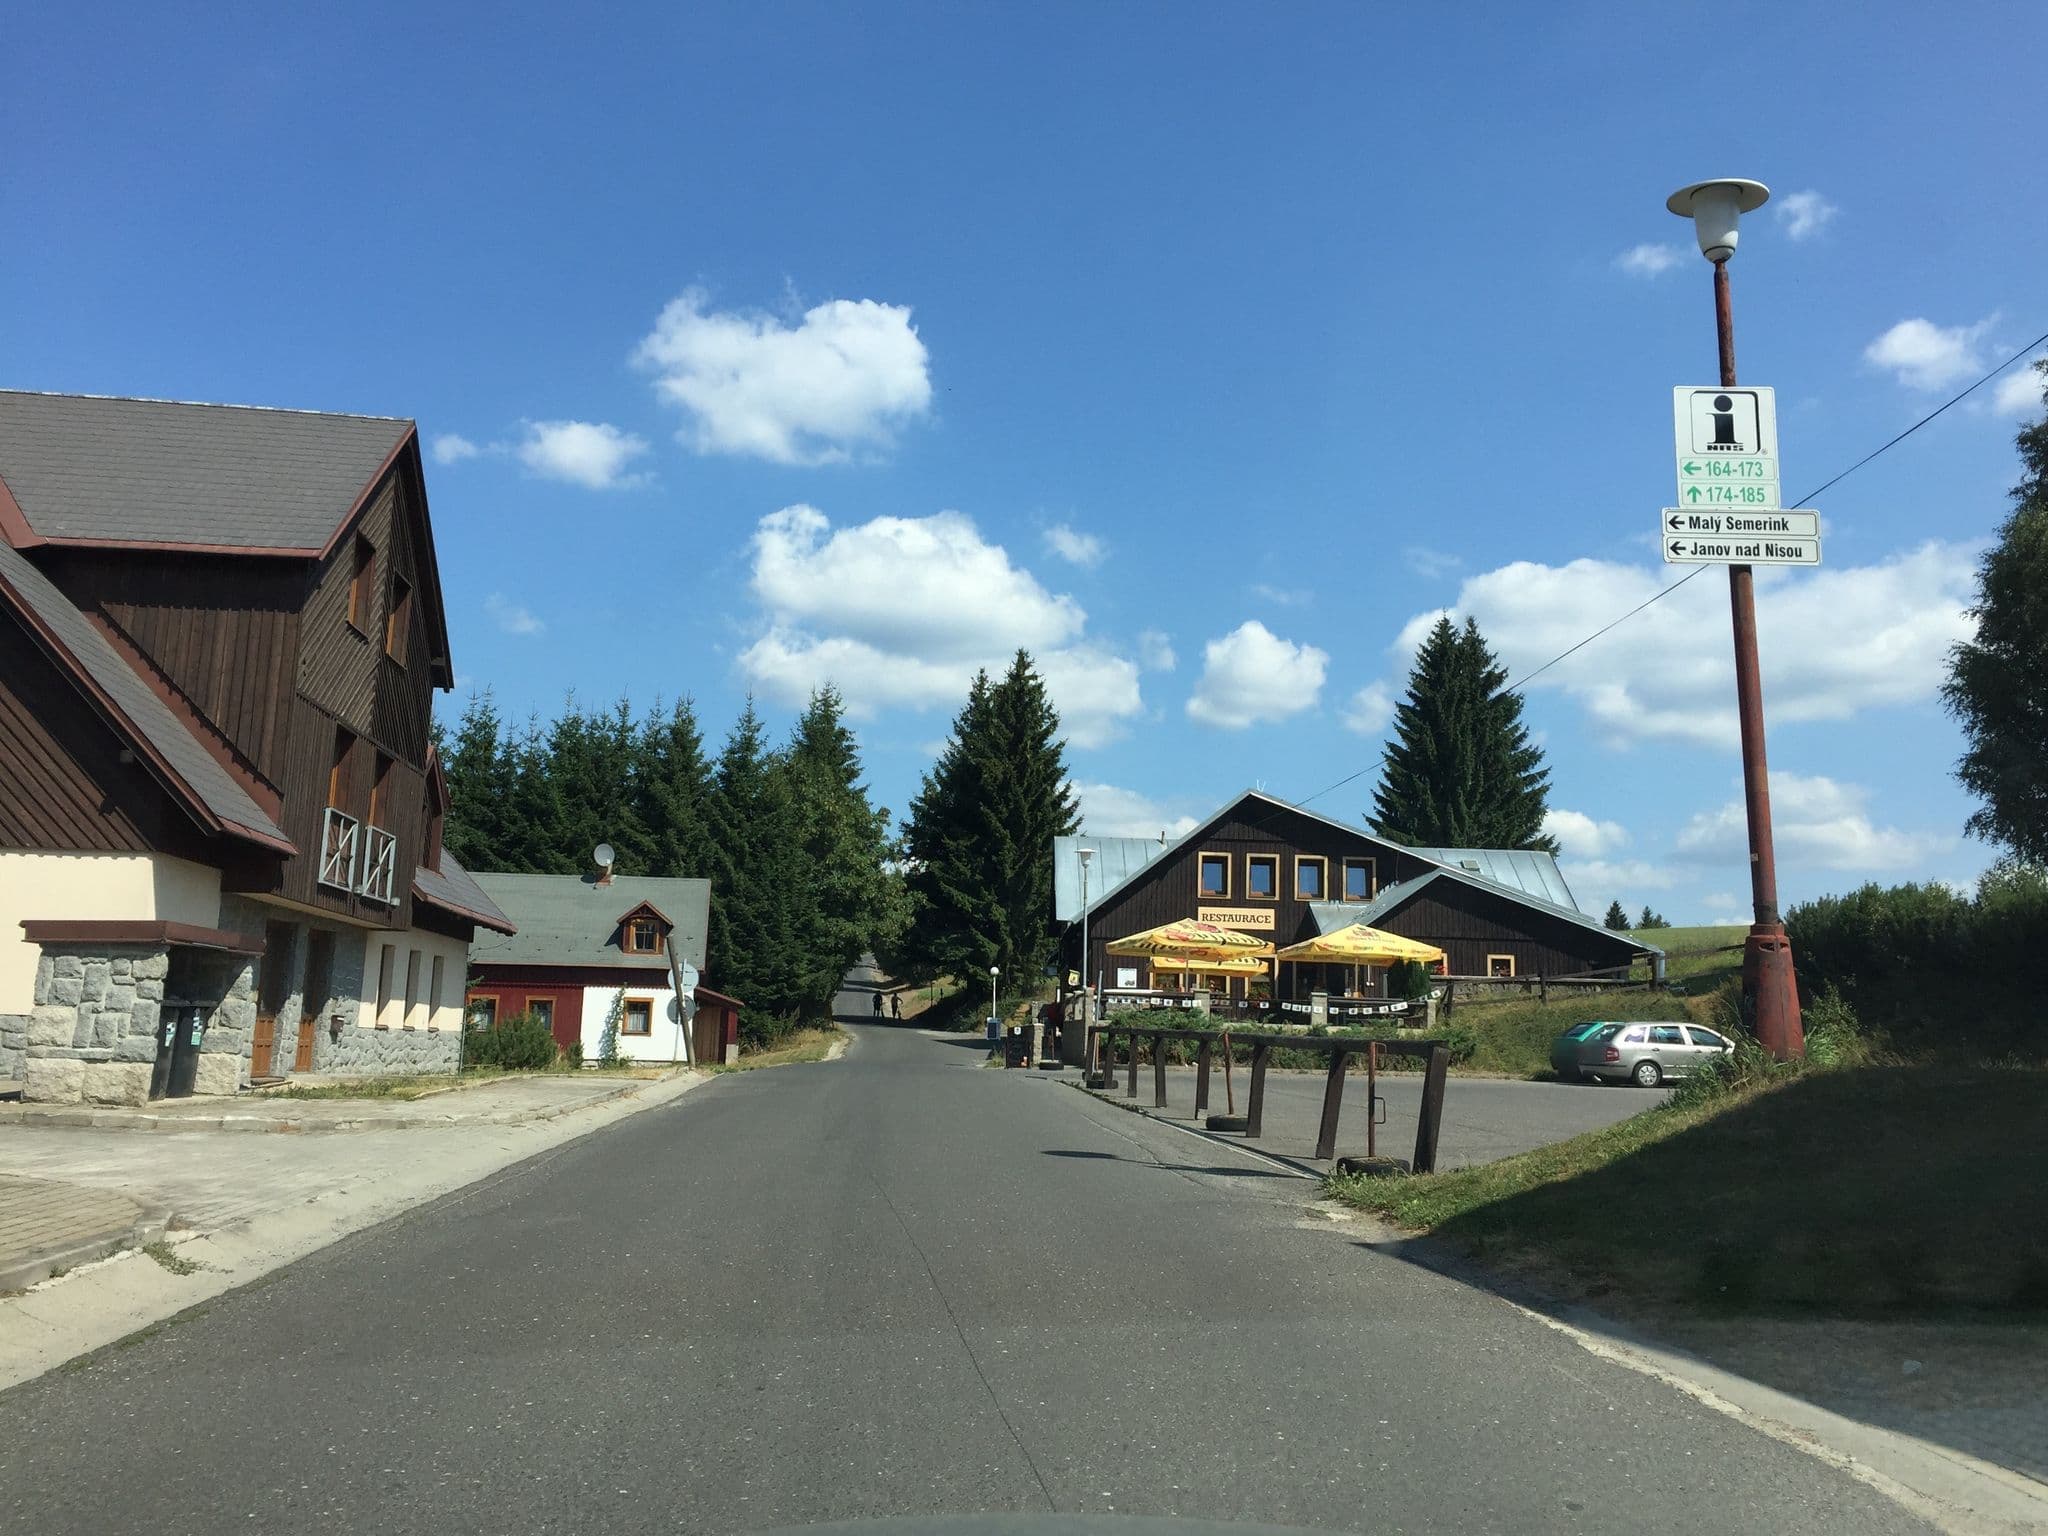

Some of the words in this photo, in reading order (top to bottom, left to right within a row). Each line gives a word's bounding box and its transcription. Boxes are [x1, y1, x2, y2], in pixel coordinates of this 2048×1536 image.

[1706, 461, 1763, 477] 164-173
[1707, 487, 1765, 503] 174-185
[1689, 515, 1722, 533] Malý
[1726, 516, 1790, 531] Semerink
[1690, 541, 1731, 556] Janov
[1736, 543, 1760, 557] nad
[1766, 544, 1802, 557] Nisou
[1202, 913, 1271, 924] RESTAURACE
